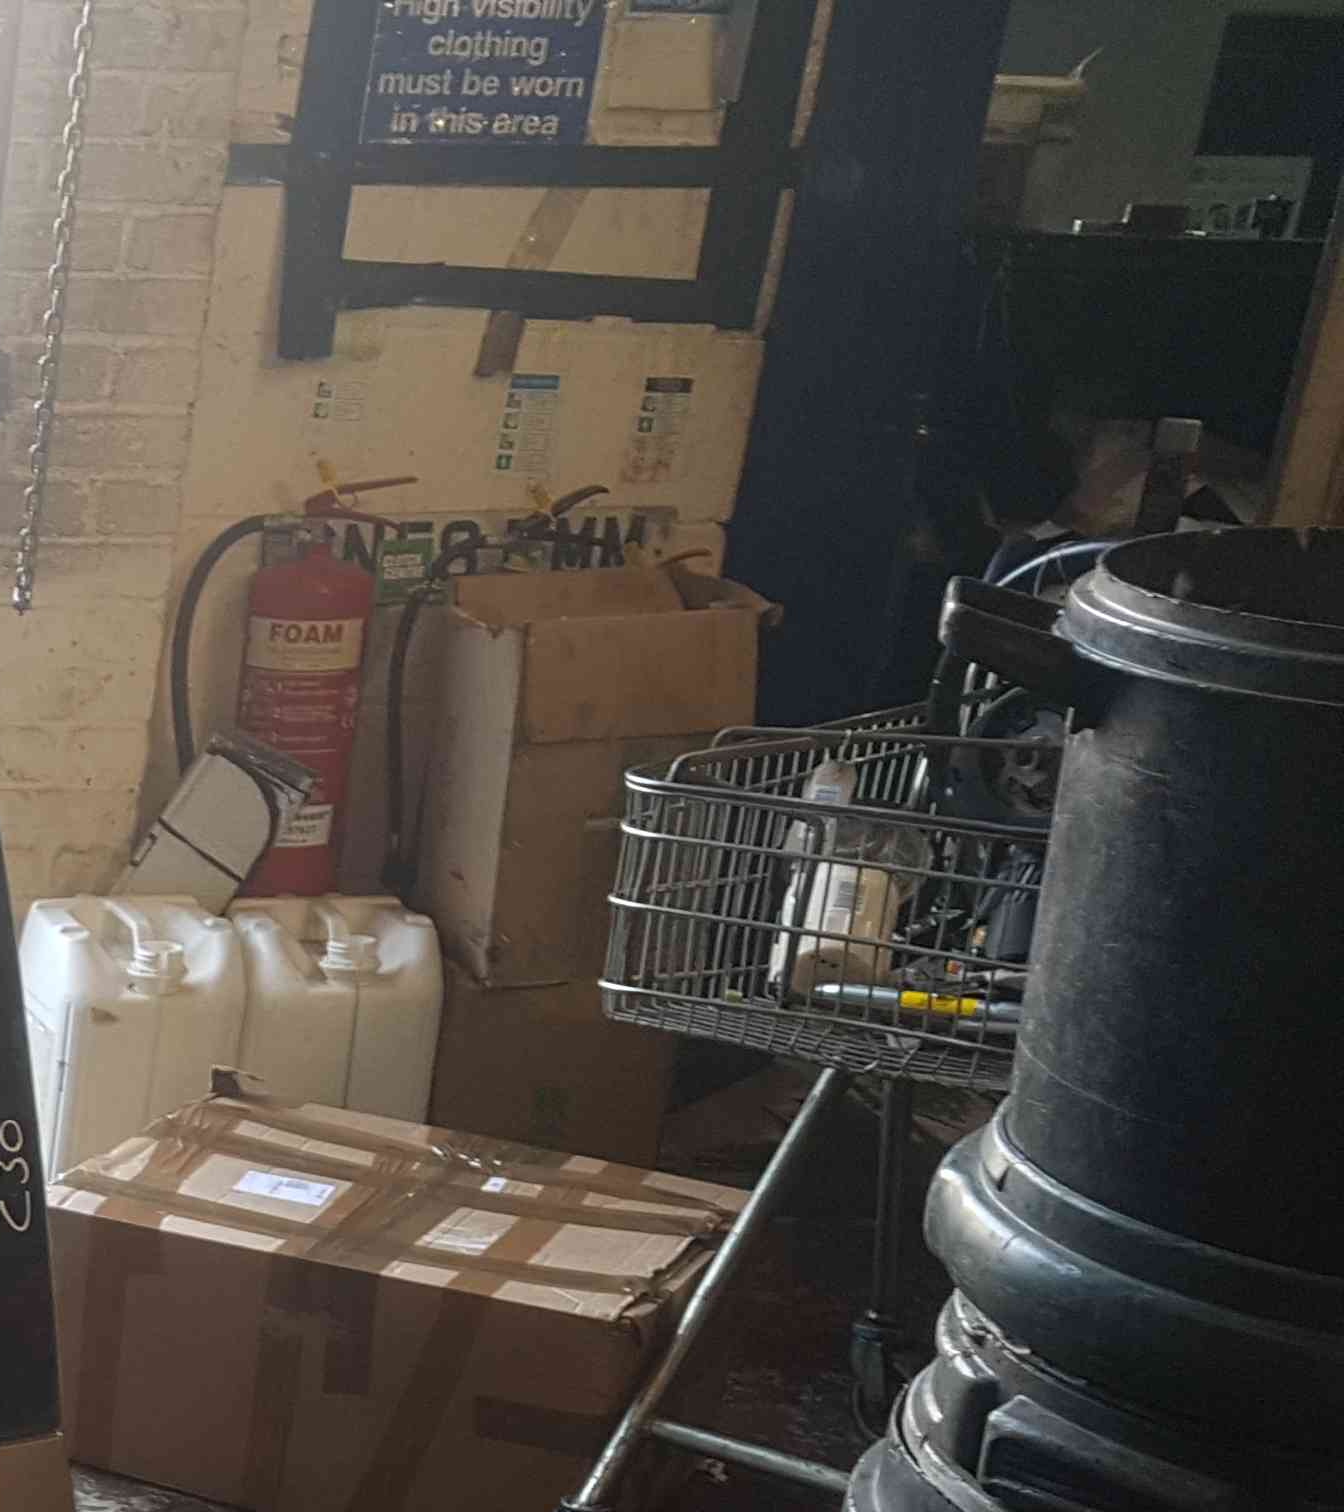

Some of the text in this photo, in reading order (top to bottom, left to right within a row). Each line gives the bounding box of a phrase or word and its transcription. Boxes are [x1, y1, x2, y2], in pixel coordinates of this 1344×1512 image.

[393, 0, 593, 26] High visibility
[427, 30, 550, 65] clothing
[378, 68, 585, 97] must be worn
[390, 106, 560, 135] in this area
[268, 622, 344, 645] FOAM
